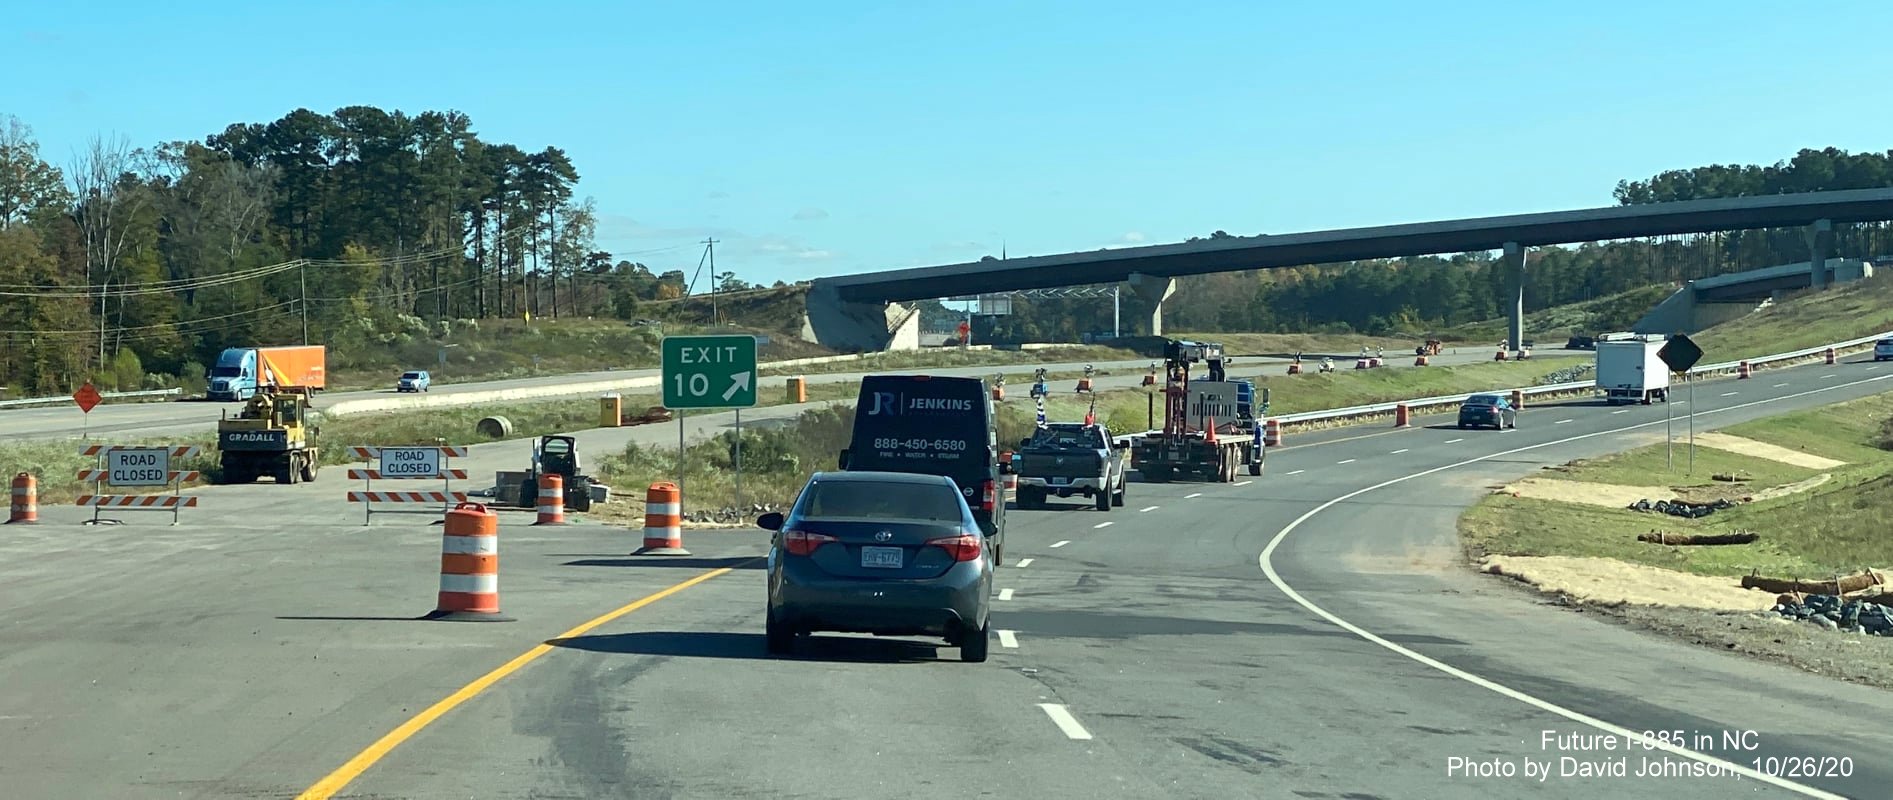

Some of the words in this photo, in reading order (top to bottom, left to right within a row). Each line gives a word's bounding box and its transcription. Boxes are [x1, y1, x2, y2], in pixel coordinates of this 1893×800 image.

[681, 347, 737, 363] EXIT
[674, 373, 709, 397] 10
[909, 398, 972, 411] JENKINS
[228, 433, 275, 442] GRADALL
[873, 438, 966, 451] 888-450-6580
[120, 454, 156, 466] ROAD
[395, 451, 425, 461] ROAD
[388, 463, 432, 473] CLOSED
[113, 470, 163, 481] CLOSED
